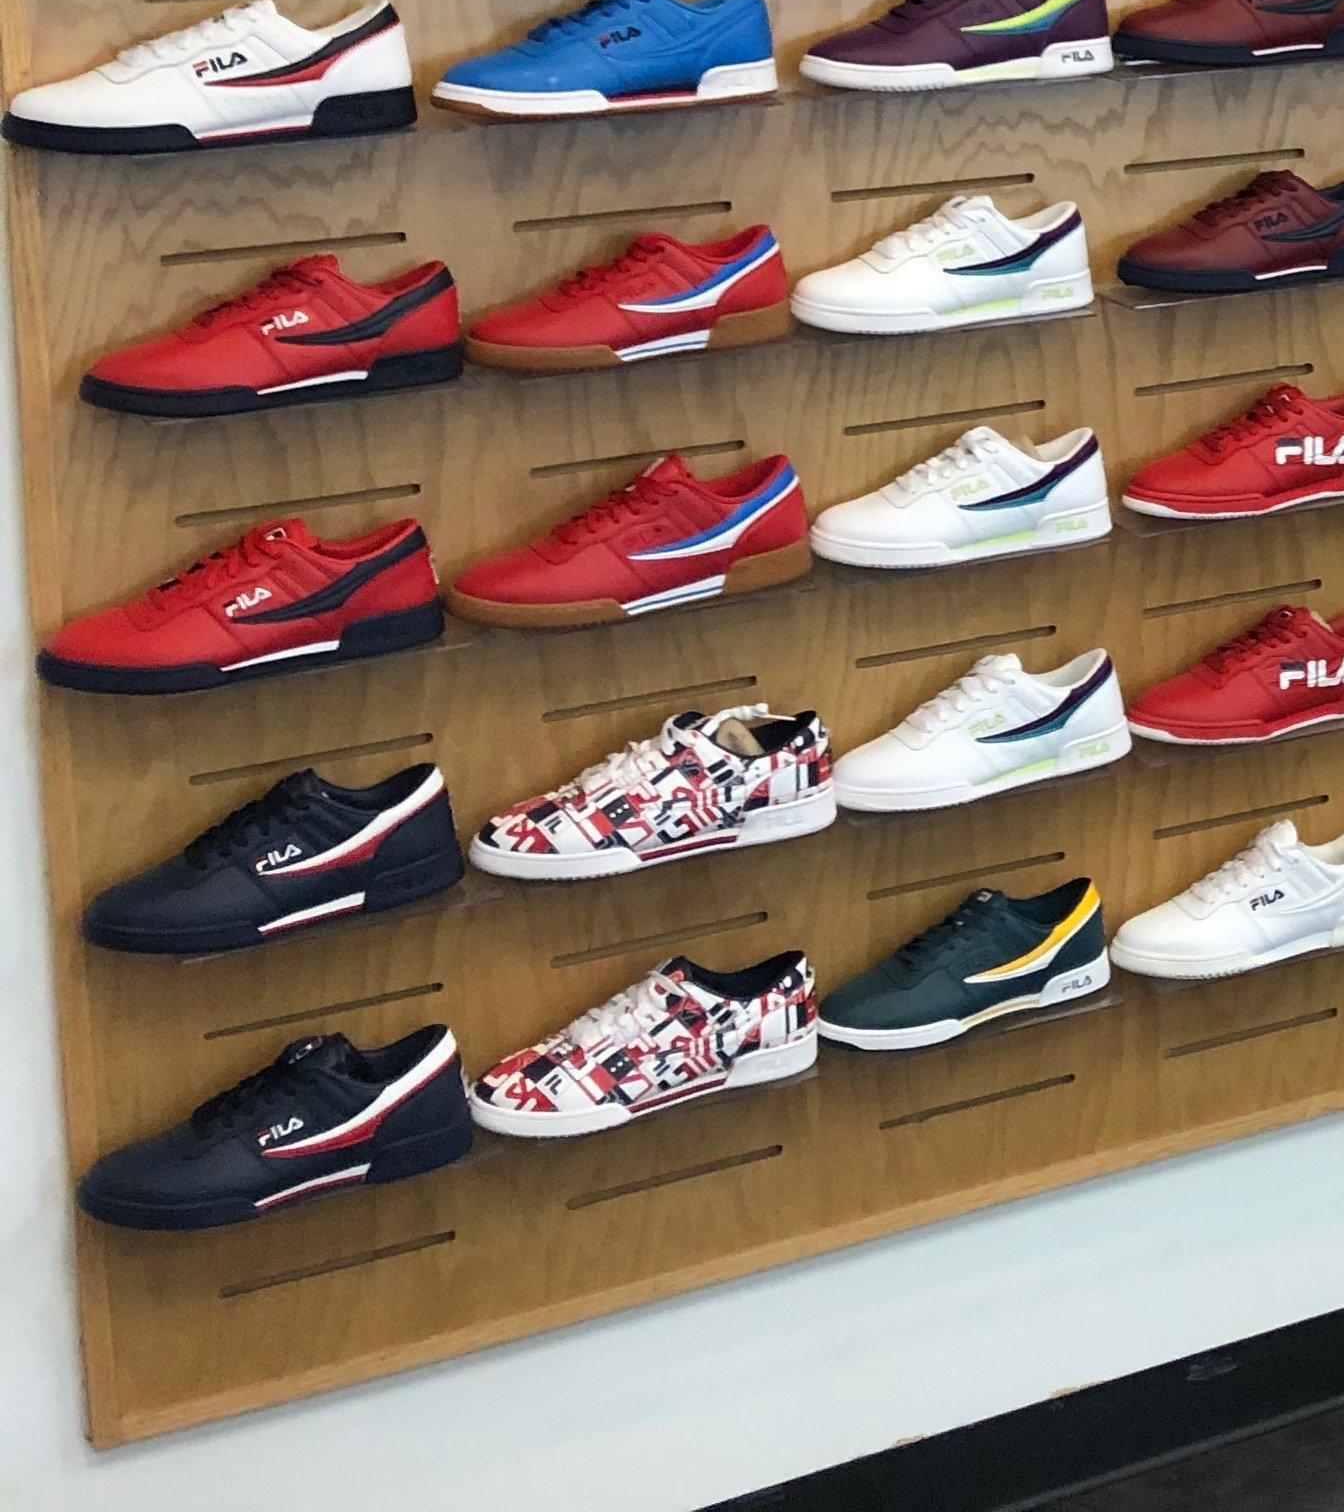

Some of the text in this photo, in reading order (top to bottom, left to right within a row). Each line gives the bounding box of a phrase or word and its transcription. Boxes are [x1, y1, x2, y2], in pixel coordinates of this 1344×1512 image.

[600, 27, 642, 48] FILA
[194, 52, 249, 77] FILA
[1061, 50, 1094, 63] FILA
[261, 311, 310, 335] FILA
[226, 586, 273, 617] FILA
[255, 843, 301, 871] FILA
[1250, 888, 1285, 911] FILA
[1061, 974, 1093, 993] FILA
[257, 1115, 305, 1146] FILA
